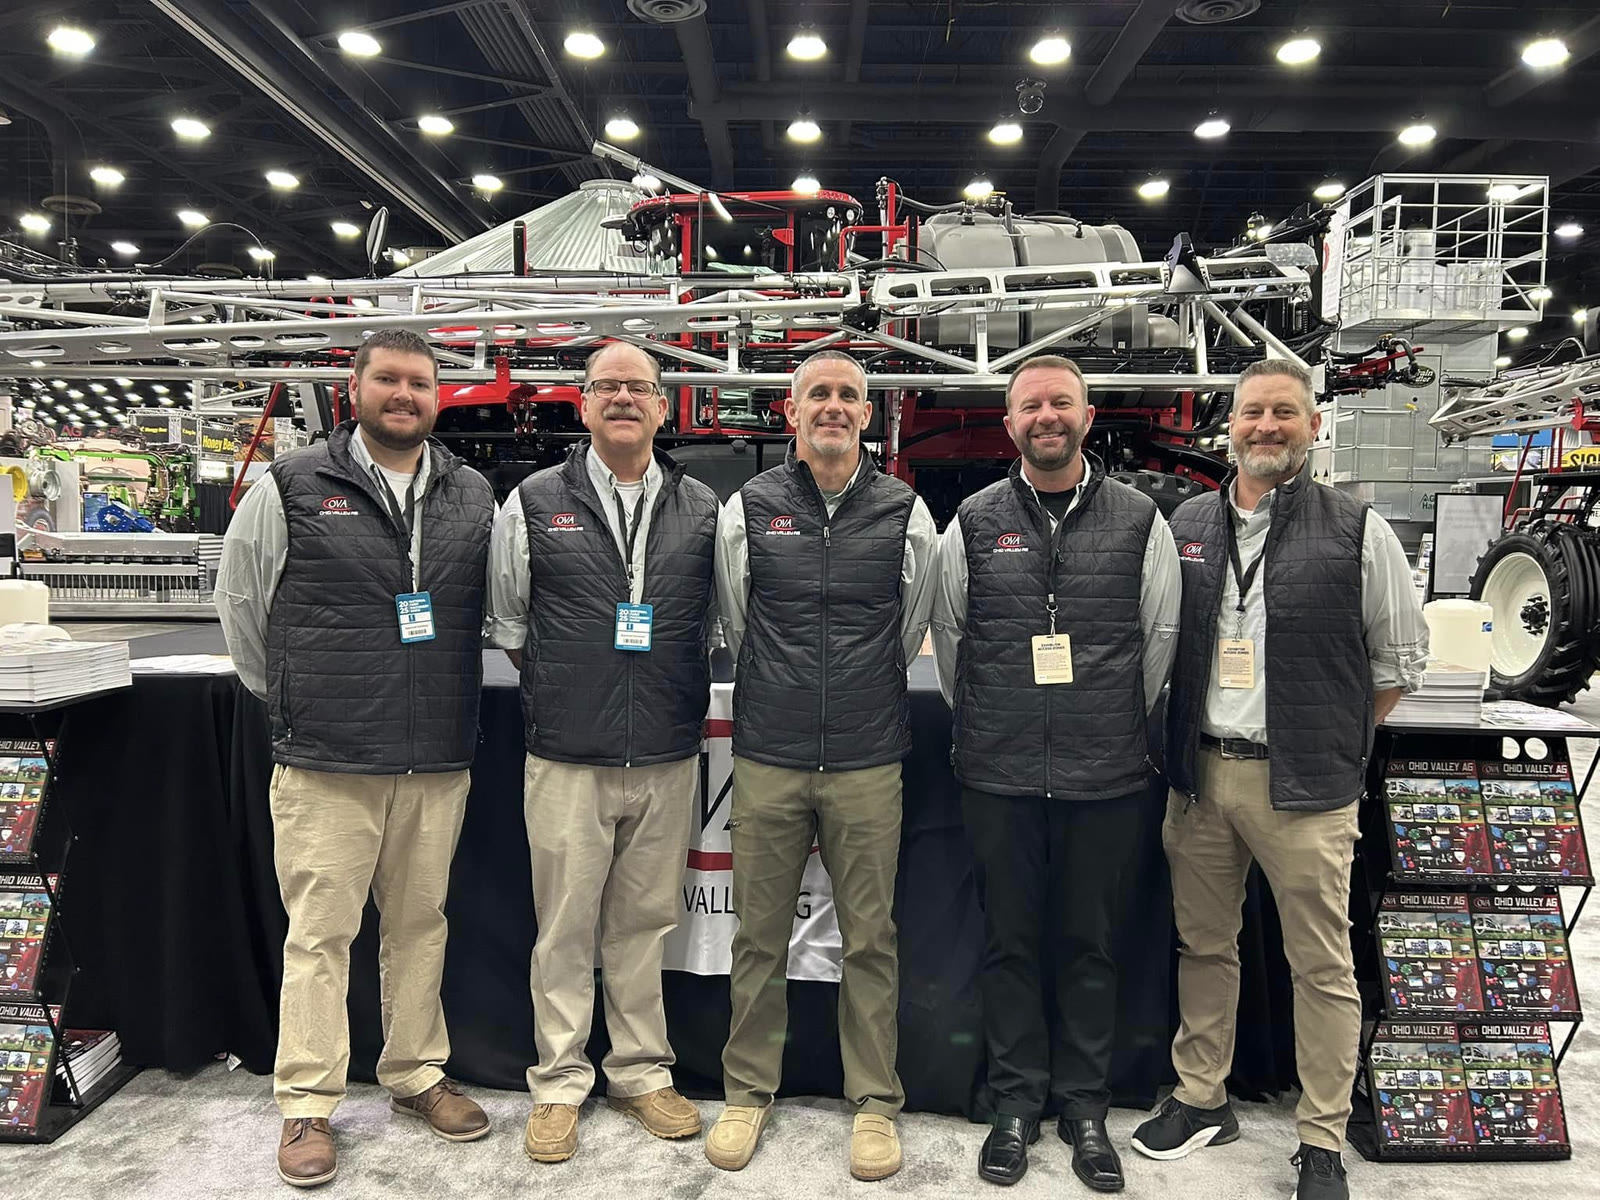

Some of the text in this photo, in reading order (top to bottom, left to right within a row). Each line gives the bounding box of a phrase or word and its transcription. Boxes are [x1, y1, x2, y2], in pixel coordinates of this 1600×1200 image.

[202, 435, 223, 452] Honey
[328, 499, 348, 508] OVA
[556, 516, 575, 525] OVA
[775, 518, 792, 528] OVA
[1002, 536, 1020, 545] OVA
[398, 600, 409, 608] 20
[400, 606, 410, 614] 25
[618, 608, 629, 616] 20
[13, 741, 40, 750] VALLEY
[1408, 761, 1429, 771] OHIO
[1430, 762, 1460, 772] VALLEY
[1461, 762, 1474, 772] AG
[1503, 763, 1523, 773] OHIO
[1524, 764, 1554, 774] VALLEY
[1555, 764, 1568, 774] AG
[16, 875, 43, 886] VALLEY
[683, 884, 736, 915] VALL
[1400, 895, 1420, 905] OHIO
[1421, 895, 1452, 905] VALLEY
[1453, 896, 1466, 905] AG
[1494, 896, 1513, 906] OHIO
[1515, 897, 1544, 907] VALLEY
[1545, 897, 1558, 907] AG
[19, 1007, 45, 1018] VALLEY
[1391, 1025, 1411, 1035] OHIO
[1412, 1025, 1441, 1035] VALLEY
[1443, 1026, 1455, 1035] AG
[1481, 1025, 1501, 1035] OHIO
[1502, 1025, 1532, 1035] VALLEY
[1533, 1026, 1545, 1036] AG
